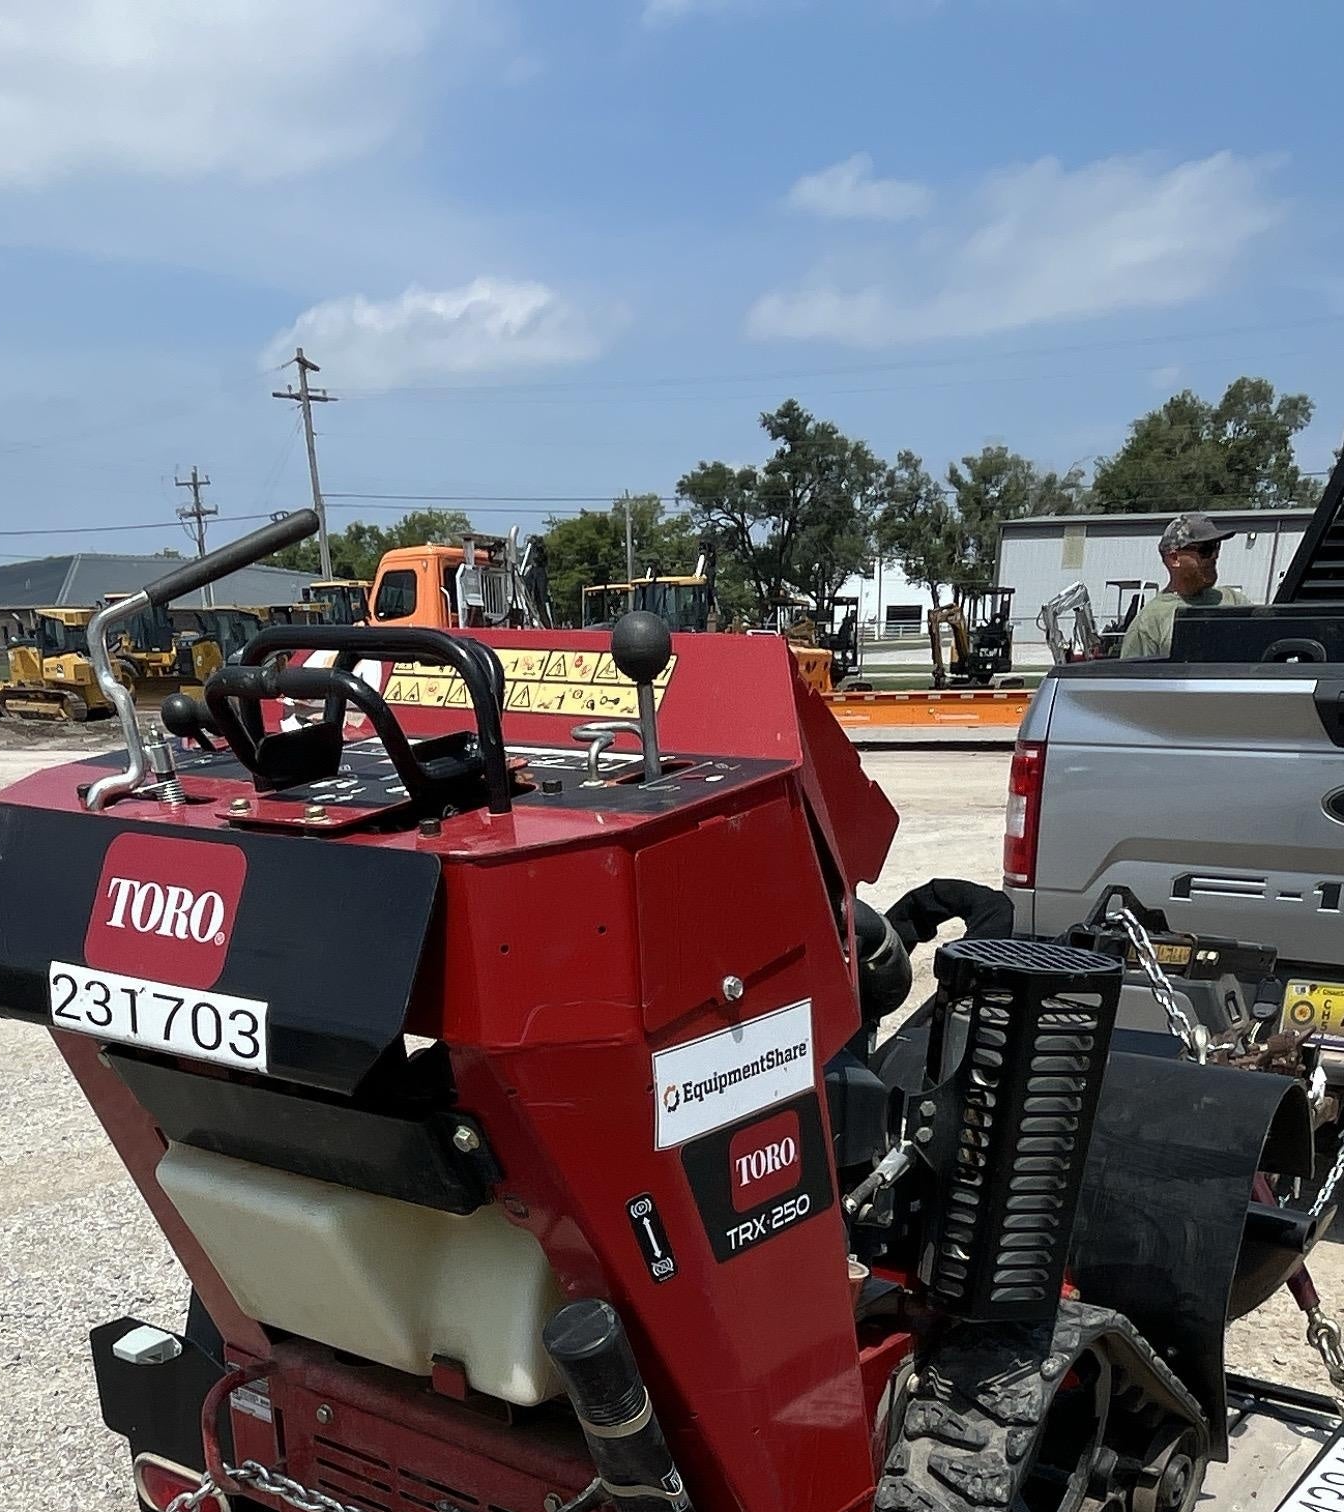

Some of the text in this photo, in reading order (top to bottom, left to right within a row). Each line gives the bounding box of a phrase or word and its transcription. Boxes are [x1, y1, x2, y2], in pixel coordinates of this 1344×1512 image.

[106, 876, 225, 944] TORO
[51, 972, 261, 1059] 231703
[681, 1040, 809, 1104] EquipmentShare
[735, 1136, 796, 1187] TORO
